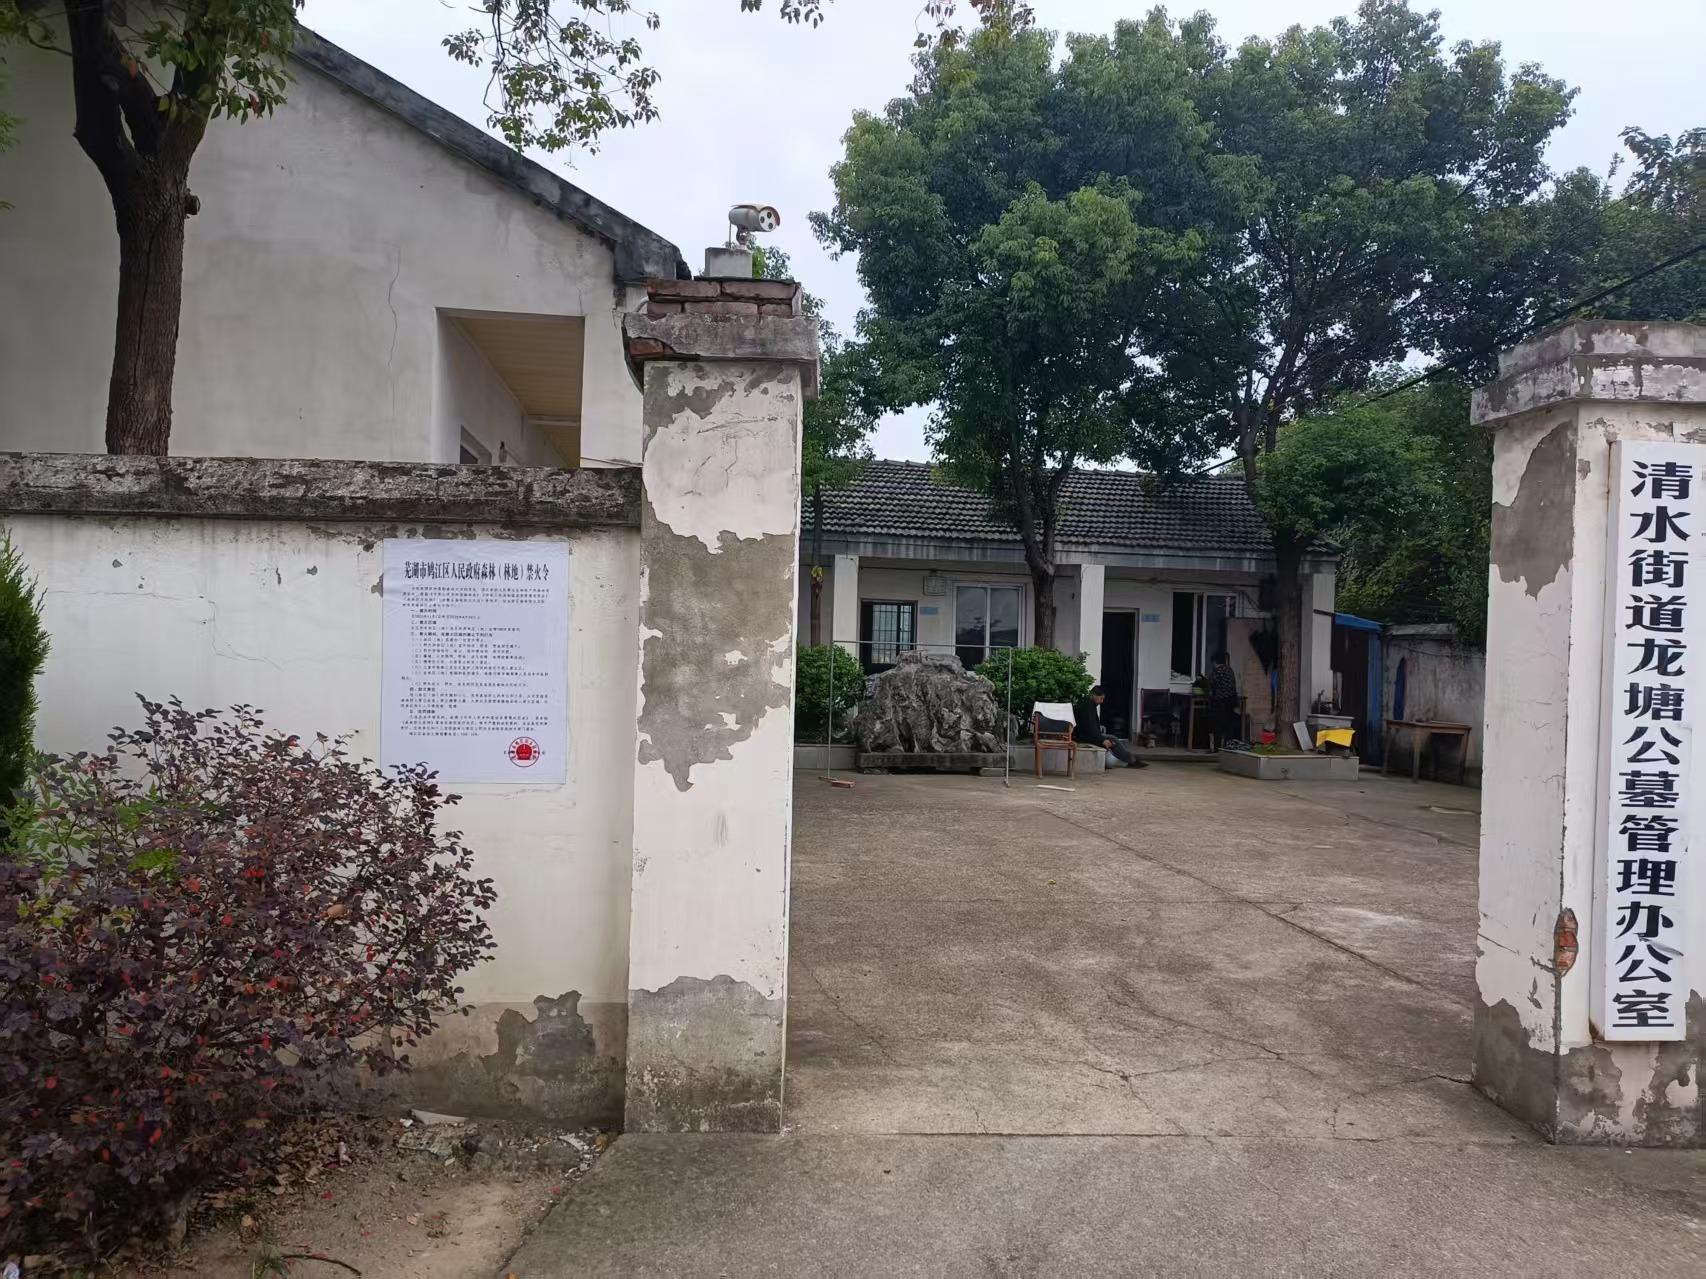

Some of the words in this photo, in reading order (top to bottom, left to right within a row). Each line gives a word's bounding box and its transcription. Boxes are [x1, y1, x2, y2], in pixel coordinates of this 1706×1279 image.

[1612, 460, 1694, 1028] 清水街道龙塘公墓管理办公室
